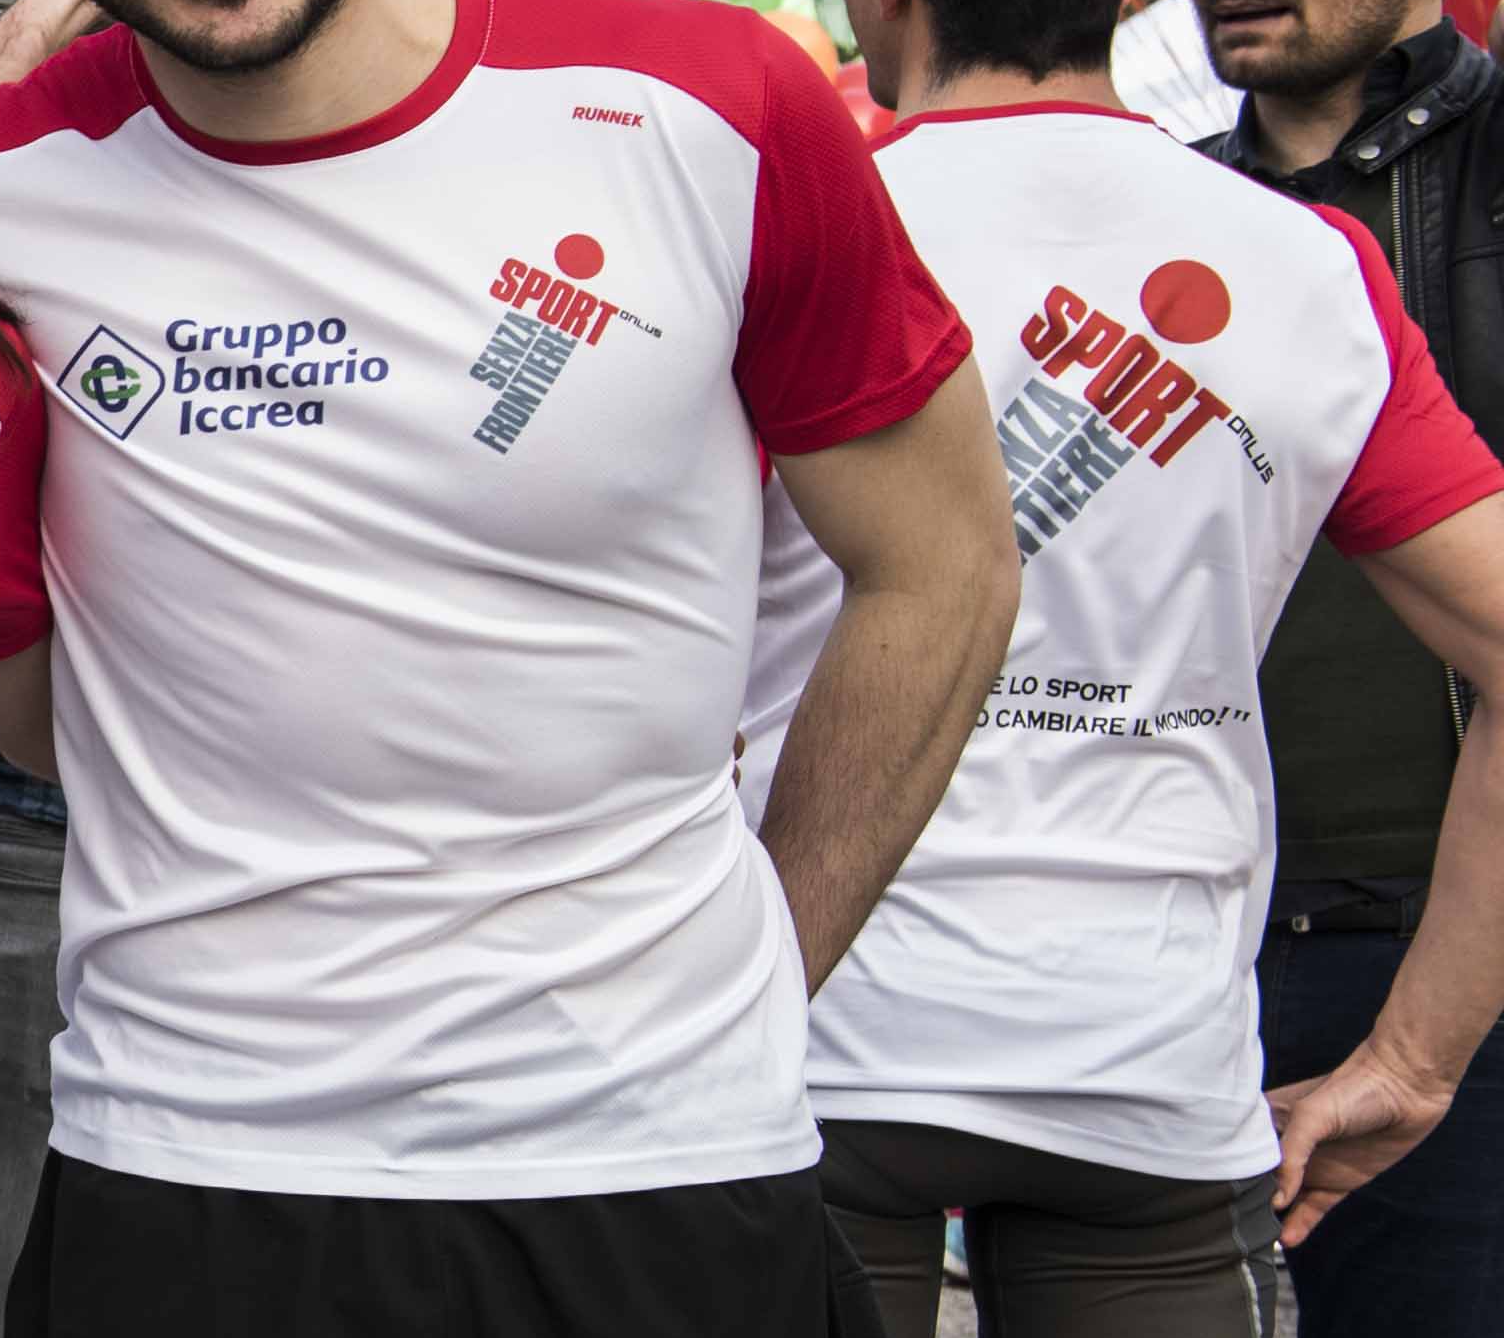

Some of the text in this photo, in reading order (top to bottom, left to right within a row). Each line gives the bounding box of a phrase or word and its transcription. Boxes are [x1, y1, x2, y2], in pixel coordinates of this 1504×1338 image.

[572, 106, 645, 128] RUNNEK
[488, 258, 621, 348] SPORT
[619, 310, 662, 339] ONLUS
[165, 317, 347, 359] Gruppo
[468, 310, 541, 393] SENZA
[173, 349, 389, 394] bancario
[472, 324, 579, 456] FRONTIERE
[1019, 284, 1233, 469] SPORT
[179, 397, 324, 437] Iccrea
[1227, 414, 1275, 485] ONLUS
[1010, 676, 1132, 703] LO SPORT
[996, 710, 1125, 735] CAMBIARE
[1133, 719, 1152, 736] IL
